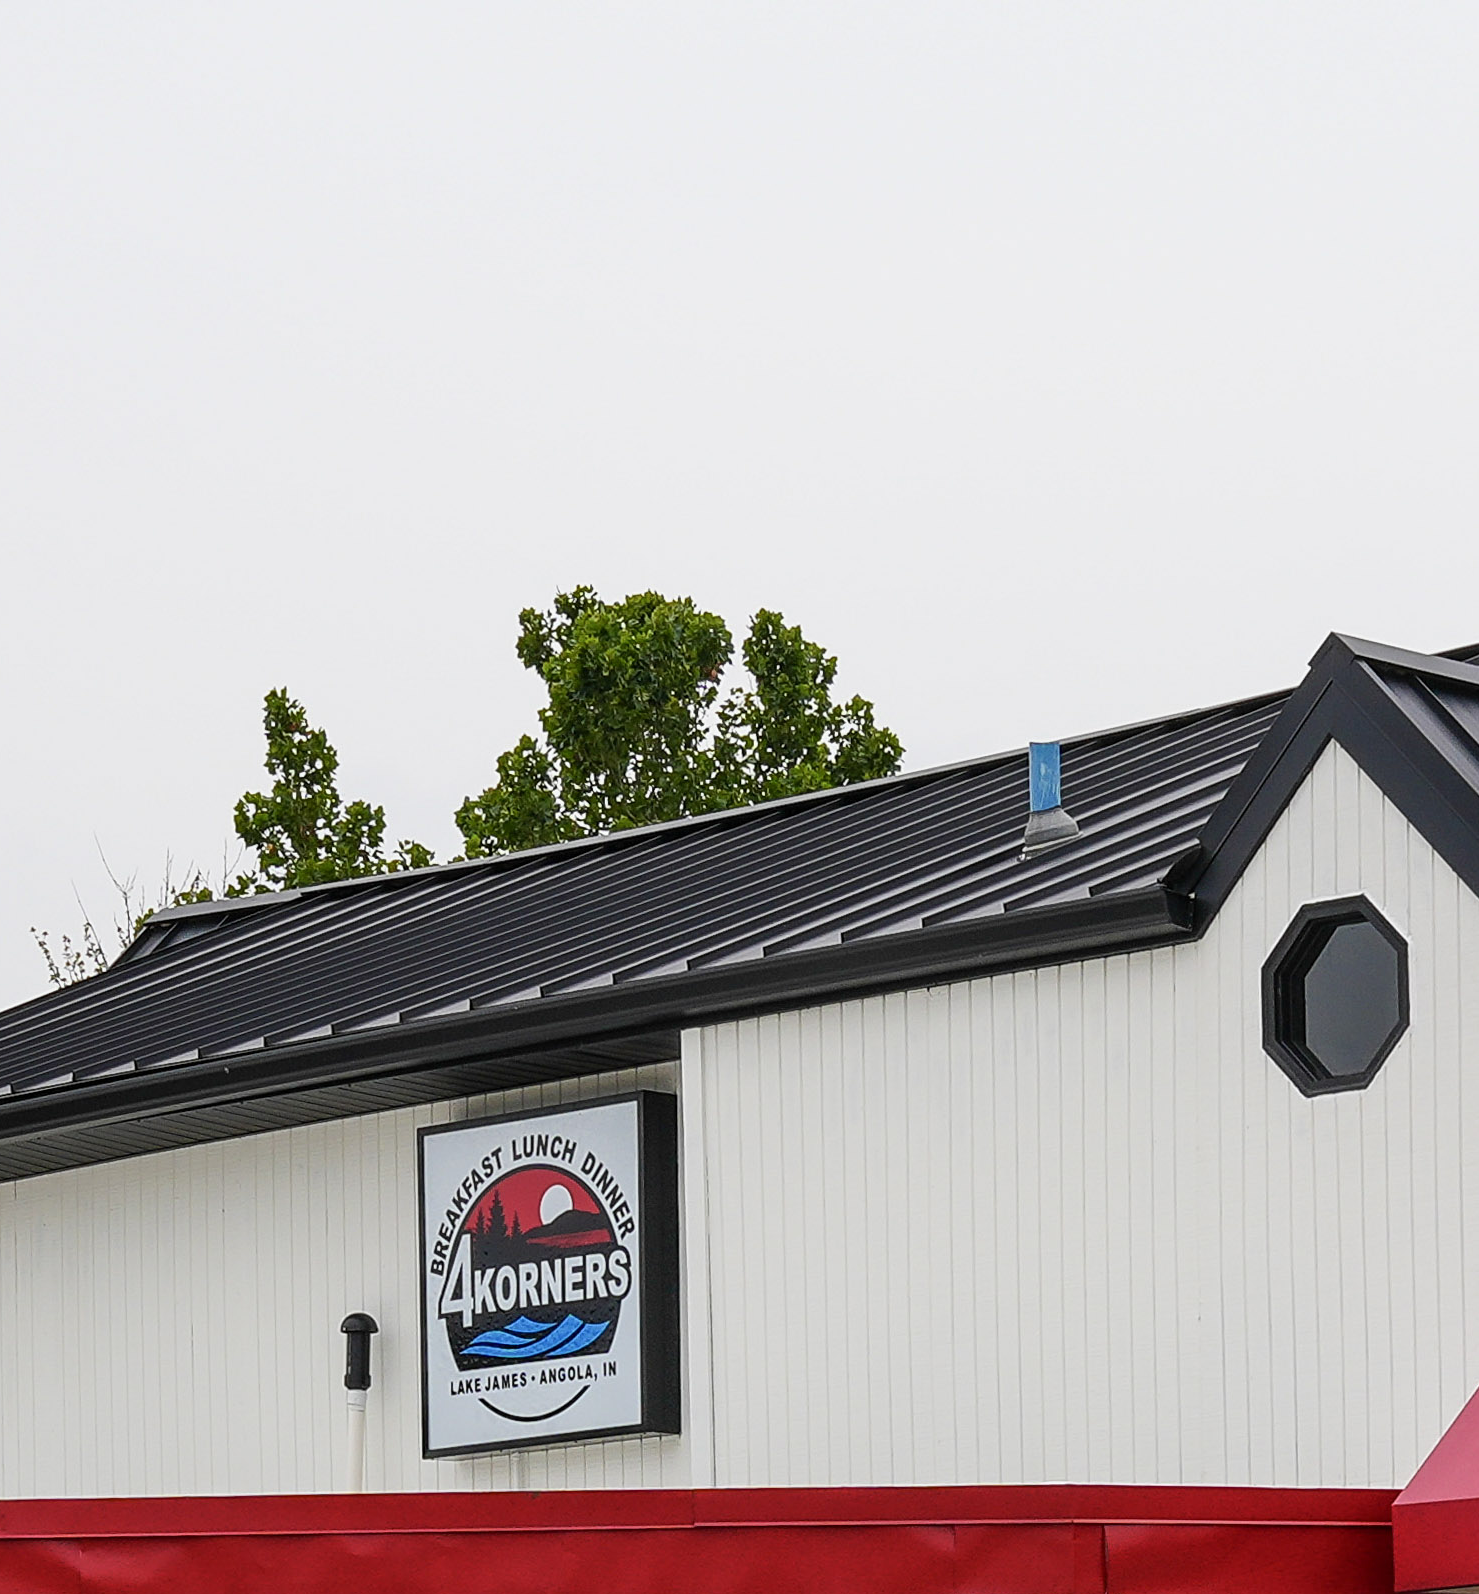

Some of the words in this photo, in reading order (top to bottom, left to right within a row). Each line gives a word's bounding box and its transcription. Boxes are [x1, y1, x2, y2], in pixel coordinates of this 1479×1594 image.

[431, 1147, 503, 1277] BREAKFAST
[512, 1134, 577, 1163] LUNCH
[581, 1151, 636, 1238] DINNER
[440, 1233, 631, 1329] 4KORNERS
[450, 1380, 482, 1396] LAKE
[485, 1372, 527, 1391] JAMES
[539, 1366, 598, 1384] ANGOLA,
[603, 1361, 617, 1378] IN
